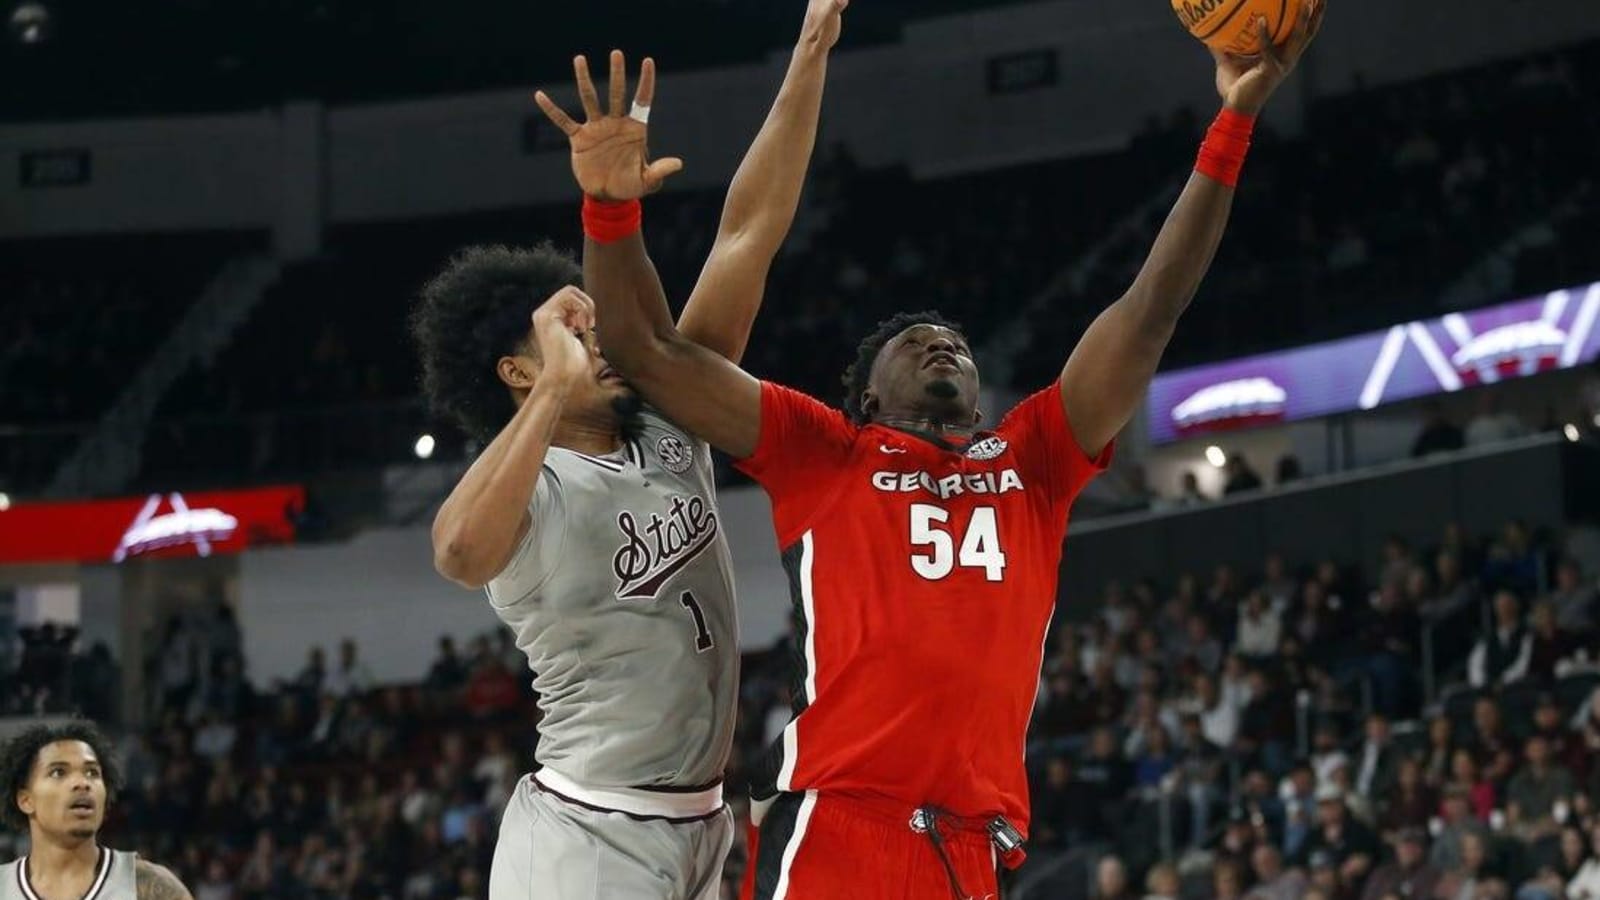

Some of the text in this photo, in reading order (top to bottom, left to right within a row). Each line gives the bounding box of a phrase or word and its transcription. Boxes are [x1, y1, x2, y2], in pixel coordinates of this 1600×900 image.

[659, 437, 682, 464] SEC
[871, 468, 1025, 500] GEORGIA
[613, 496, 717, 598] State
[909, 502, 1007, 582] 54
[680, 590, 714, 653] 1
